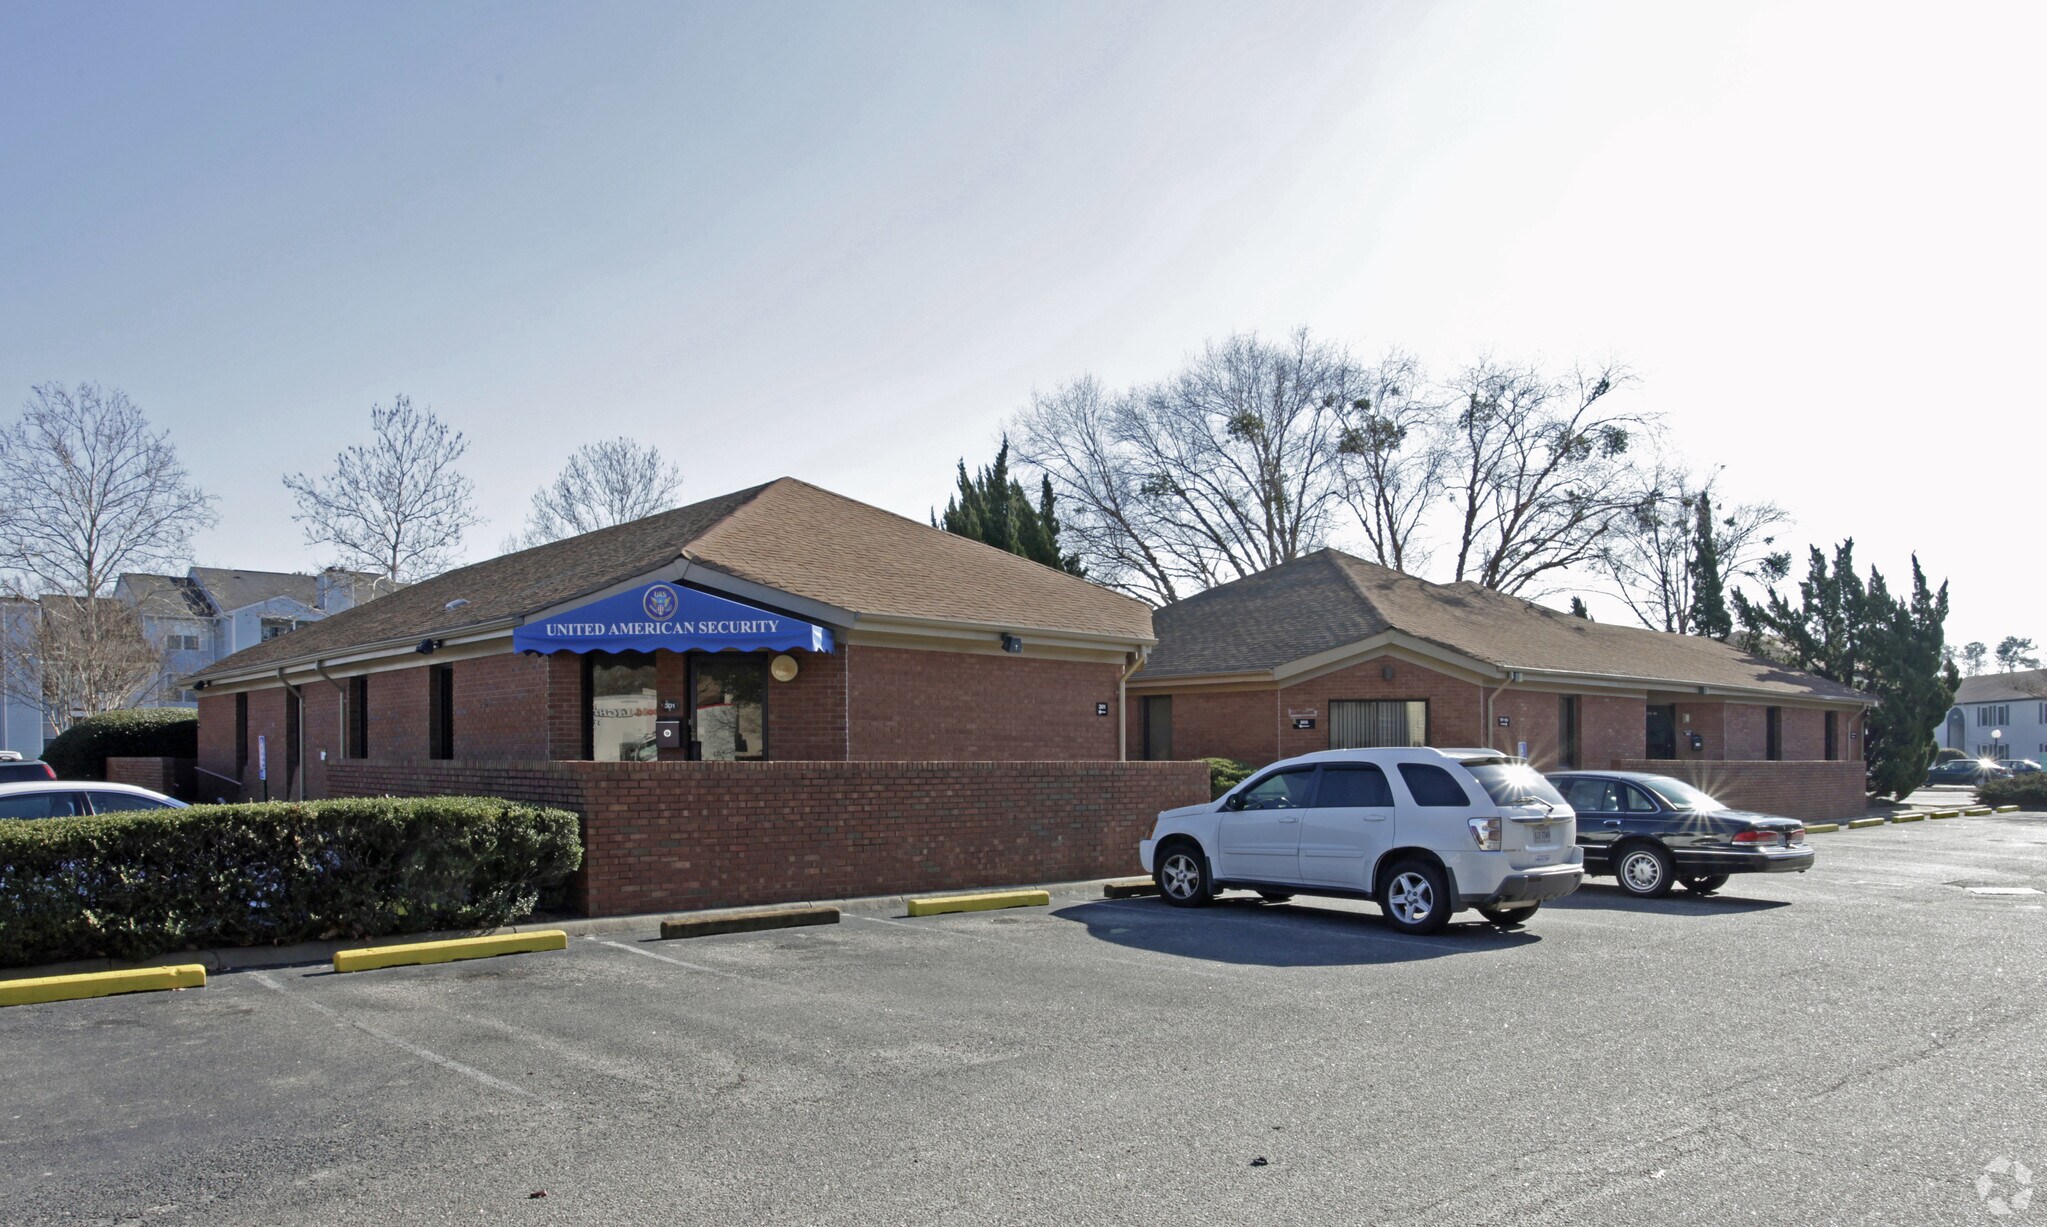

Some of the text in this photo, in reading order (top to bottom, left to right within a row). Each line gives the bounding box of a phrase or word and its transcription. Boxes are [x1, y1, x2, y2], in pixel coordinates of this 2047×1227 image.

[546, 620, 779, 636] UNITED AMERICAN SECURITY
